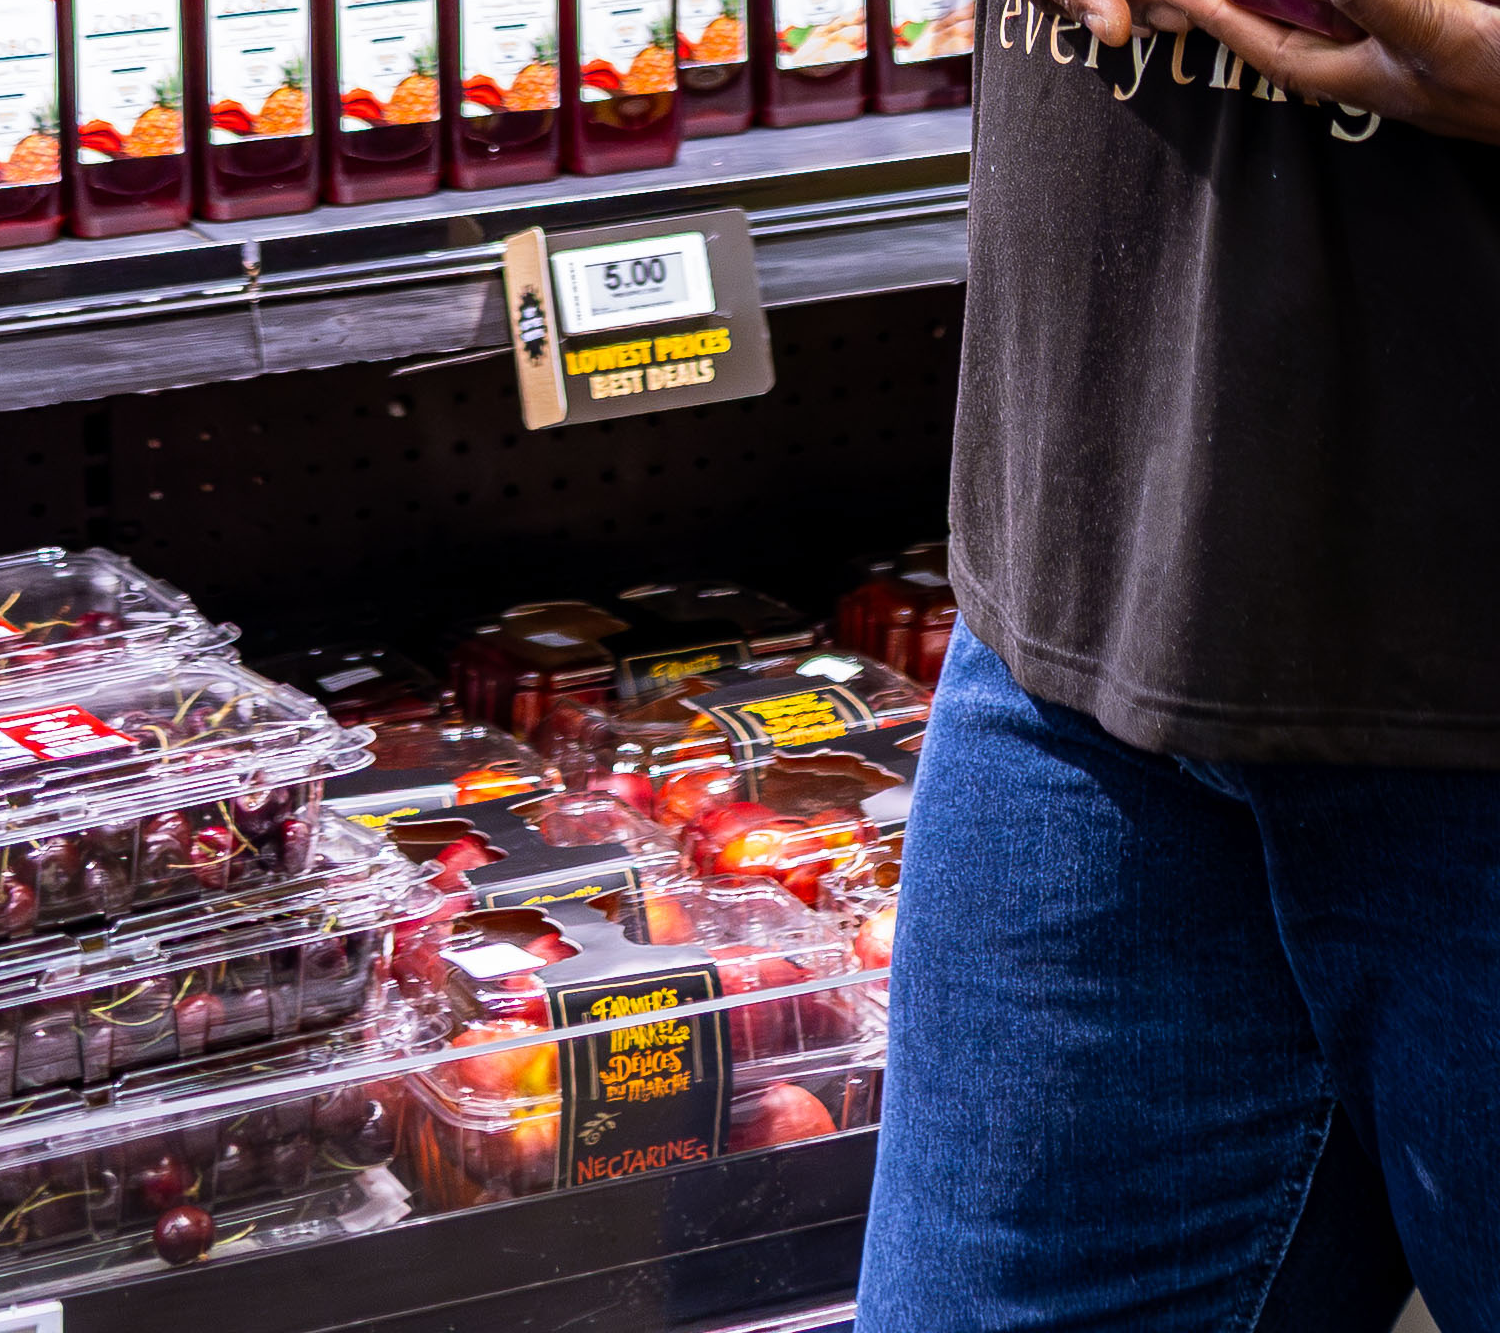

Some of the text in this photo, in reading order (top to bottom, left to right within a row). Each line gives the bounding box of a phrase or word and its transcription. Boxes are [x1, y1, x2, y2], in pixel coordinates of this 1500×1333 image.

[604, 258, 667, 290] 5.00
[564, 327, 730, 376] LOWEST PRICES
[589, 358, 715, 400] BEST DEALS
[590, 987, 678, 1020] FARMER'S
[610, 1020, 676, 1053] MARKET
[577, 1138, 708, 1184] NECTARINES
